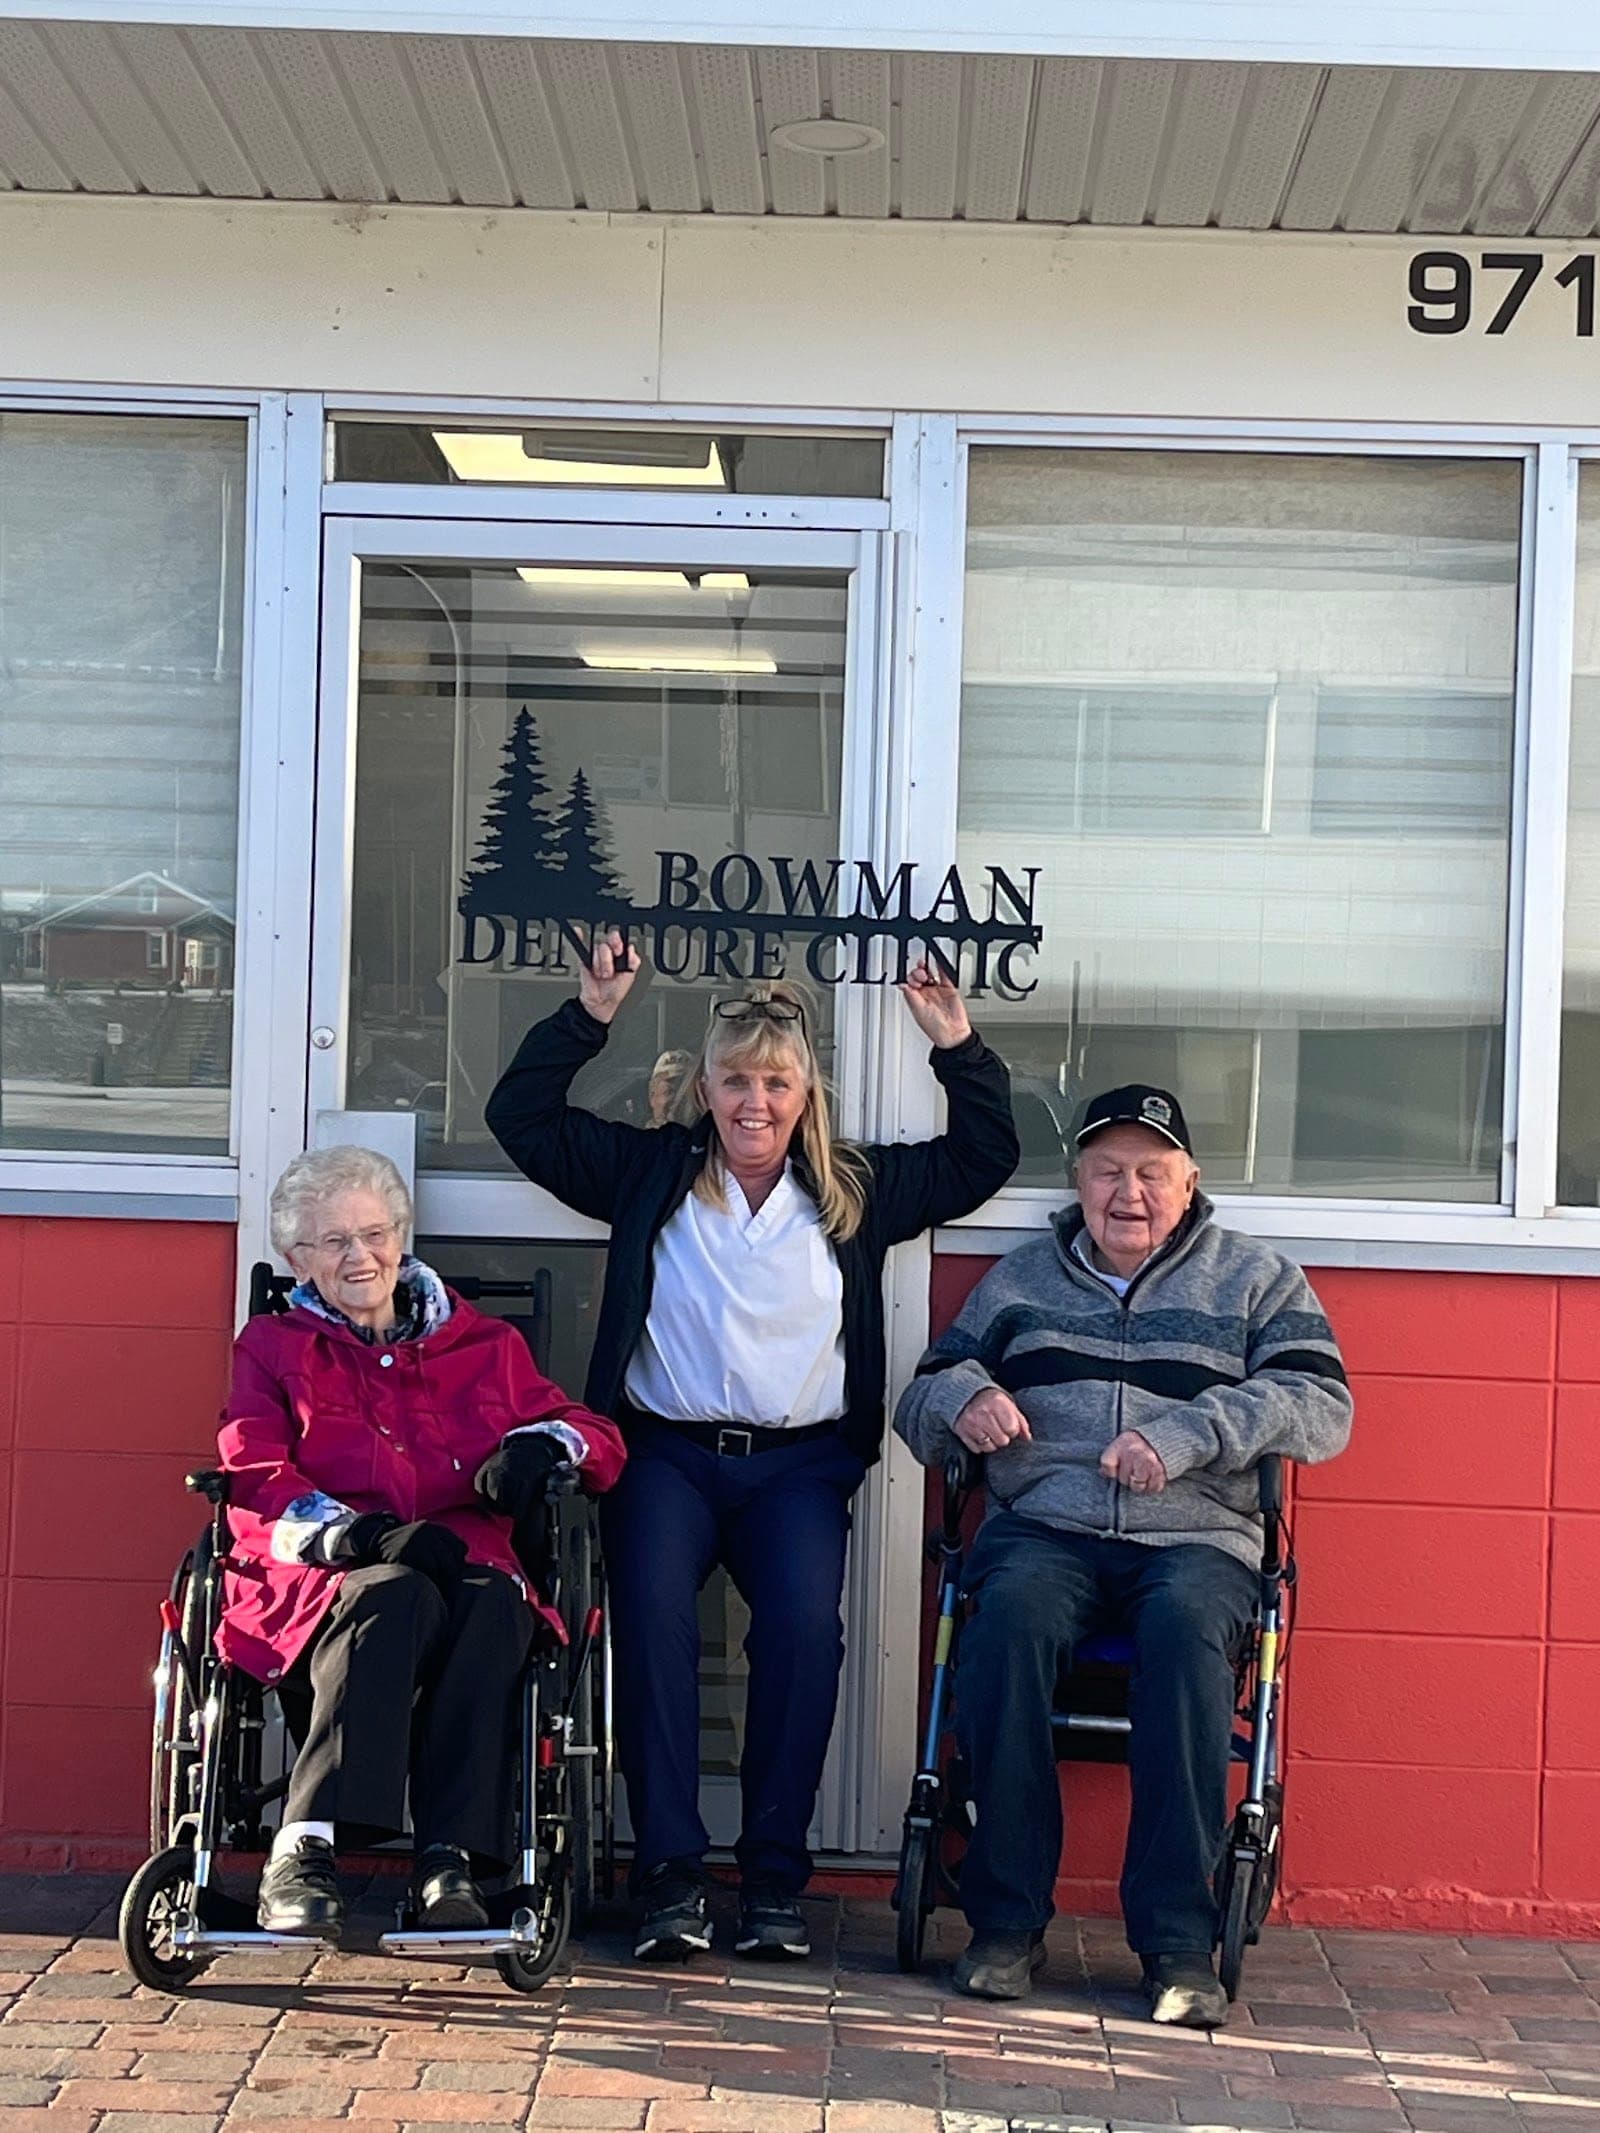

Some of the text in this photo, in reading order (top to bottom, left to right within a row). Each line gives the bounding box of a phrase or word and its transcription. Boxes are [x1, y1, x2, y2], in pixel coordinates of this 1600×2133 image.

[1407, 251, 1595, 337] 971
[654, 851, 1043, 926] BOWMAN
[806, 931, 1040, 992] CLINIC
